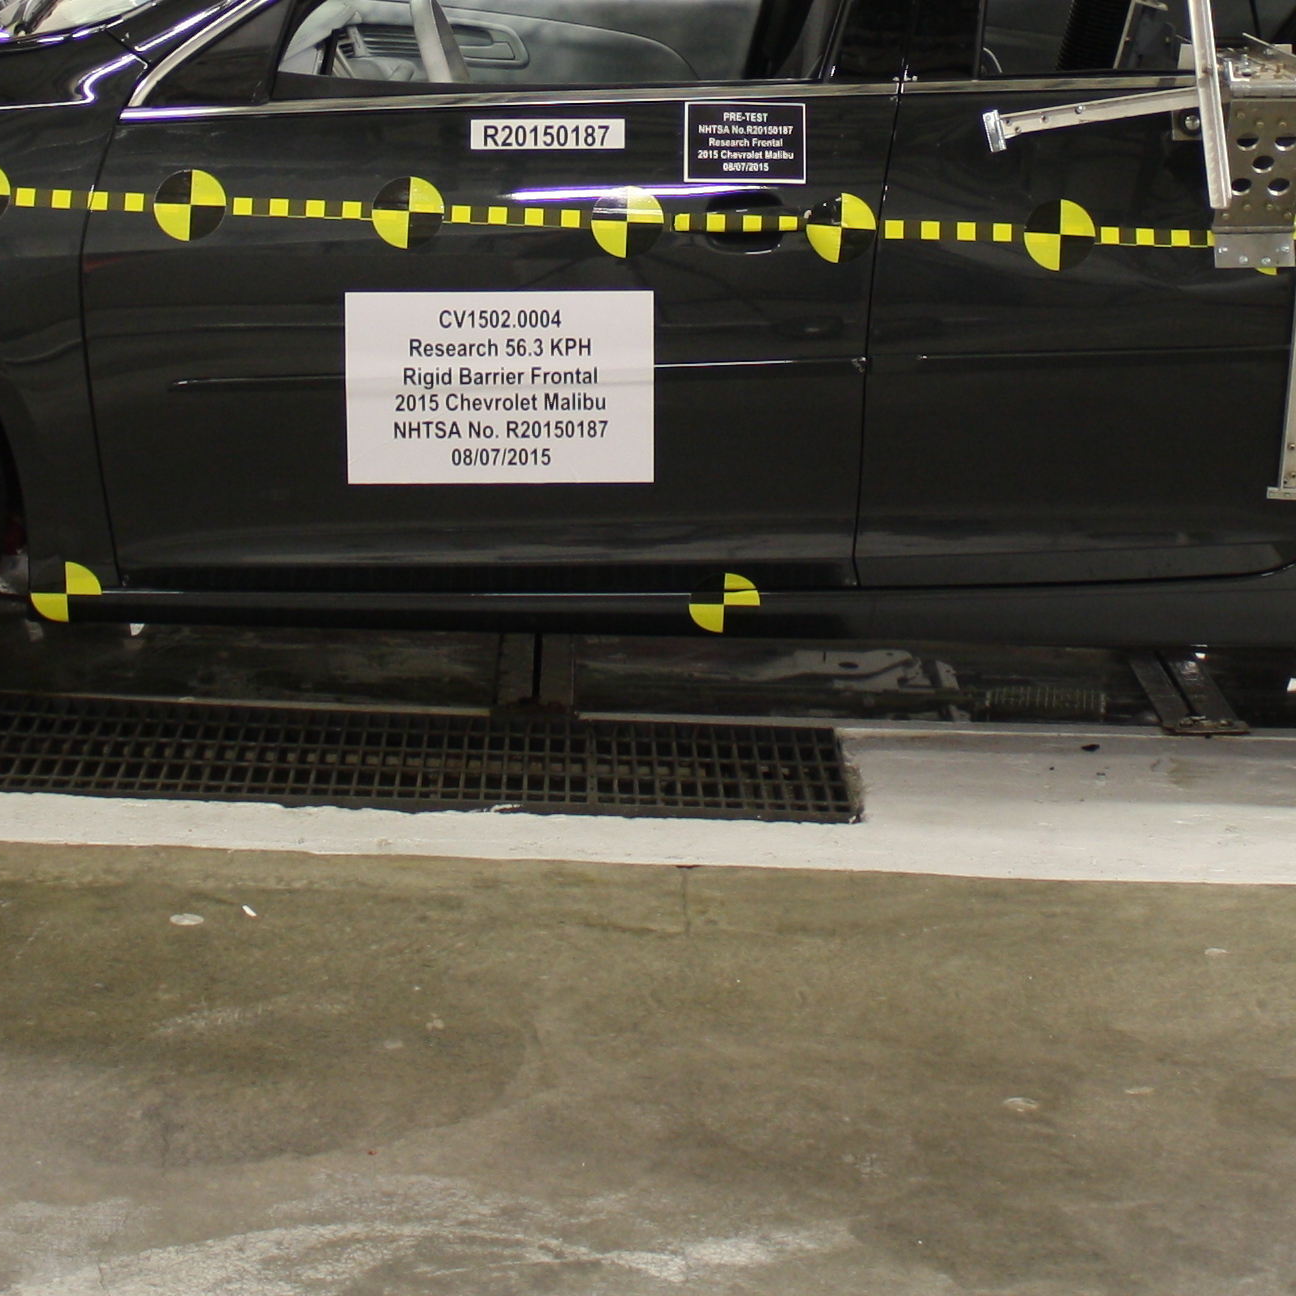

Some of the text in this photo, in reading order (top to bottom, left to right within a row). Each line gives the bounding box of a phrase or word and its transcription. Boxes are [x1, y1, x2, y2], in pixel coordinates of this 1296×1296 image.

[723, 111, 769, 122] PRE-TEST
[483, 124, 610, 147] R20150187
[698, 124, 730, 134] NHTSA
[708, 137, 783, 147] Research Frontal
[697, 150, 794, 160] 2015 Chevrolet Malibu
[722, 162, 769, 172] 08/07/2015
[439, 309, 562, 329] CV1502.0004
[409, 337, 591, 357] Research 56.3 KPH
[403, 367, 598, 390] Rigid Barrier Frontal
[395, 392, 606, 412] 2015 Chevrolet Malibu
[393, 420, 608, 439] NHTSA No. R20150187
[451, 448, 552, 467] 08/07/2015
